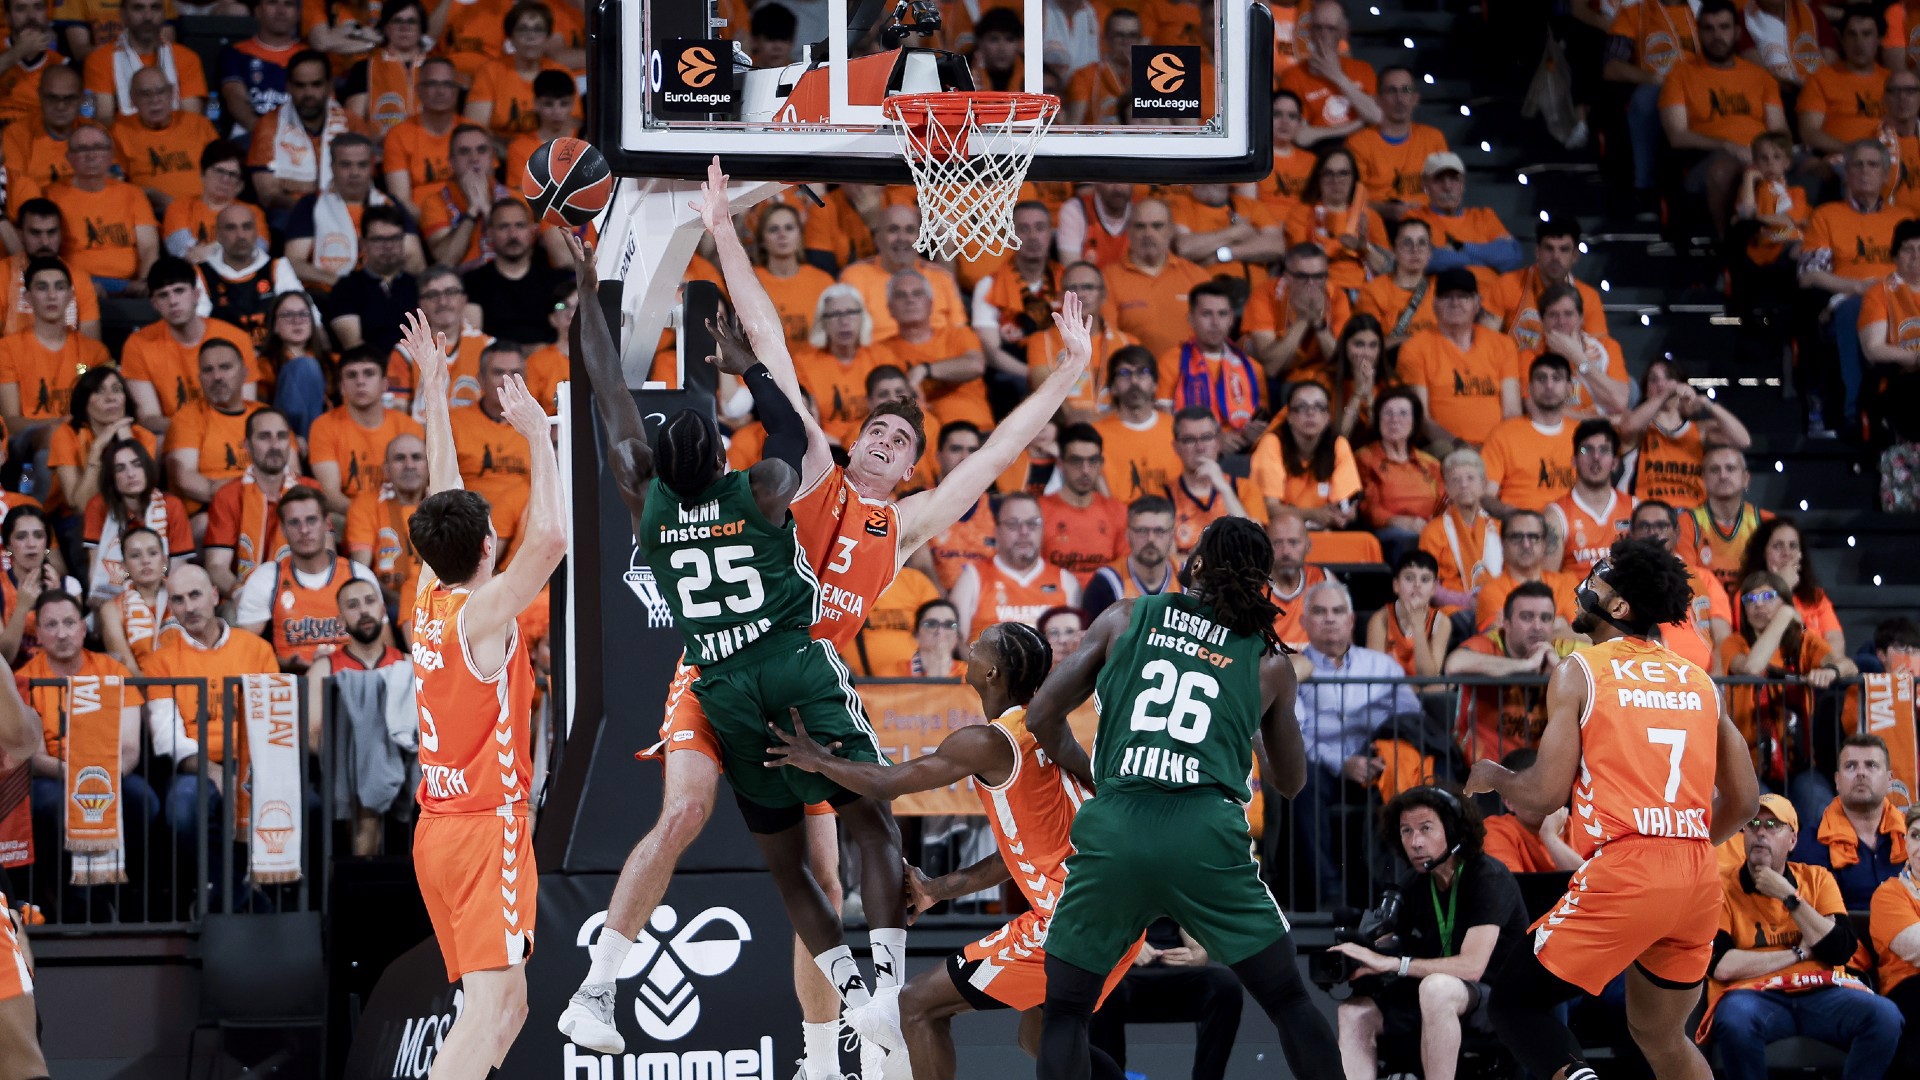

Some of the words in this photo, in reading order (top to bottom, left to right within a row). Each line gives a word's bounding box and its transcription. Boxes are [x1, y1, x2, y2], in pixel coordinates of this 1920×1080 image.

[664, 91, 731, 106] EuroLeague
[1134, 97, 1199, 111] EuroLeague
[660, 519, 746, 544] instacar
[827, 536, 859, 574] 3
[670, 545, 765, 618] 25
[1162, 606, 1231, 647] LESSORT
[1146, 627, 1234, 669] instacar
[1610, 659, 1690, 684] KEY
[1130, 658, 1220, 744] 26
[1617, 688, 1702, 711] PAMESA
[1869, 672, 1897, 732] VALE
[1119, 747, 1200, 784] ATHENS
[1647, 727, 1687, 803] 7
[563, 1035, 774, 1080] hummel
